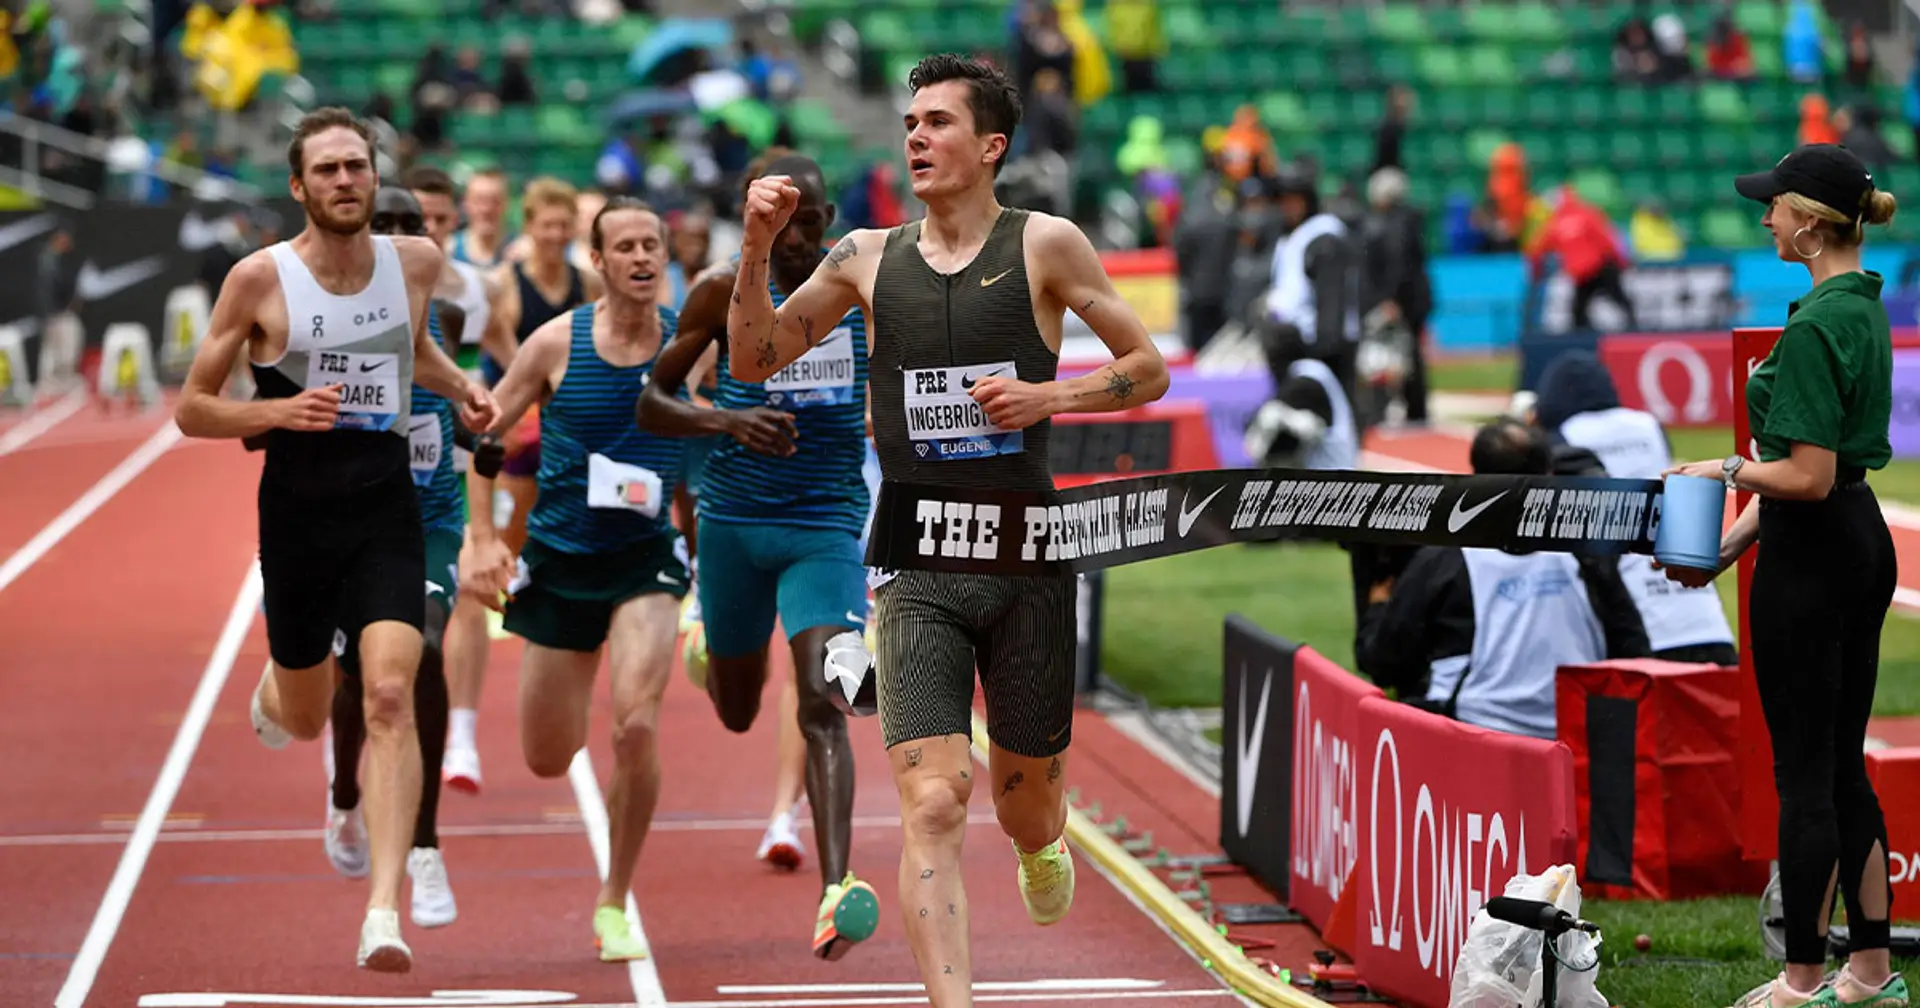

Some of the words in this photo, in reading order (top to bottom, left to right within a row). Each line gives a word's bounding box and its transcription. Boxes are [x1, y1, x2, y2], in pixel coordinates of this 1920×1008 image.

[353, 307, 389, 326] OAC
[319, 353, 349, 373] PRE
[325, 381, 386, 406] OARE
[915, 370, 948, 394] PRE
[411, 443, 437, 463] NG
[941, 441, 992, 454] EUGENE
[1230, 480, 1274, 530] THE
[1367, 484, 1445, 532] CLASSIC
[1517, 488, 1556, 538] THE
[1549, 490, 1648, 541] PREFONTAINE
[916, 499, 1002, 560] THE
[1125, 488, 1168, 548] CLASSIC
